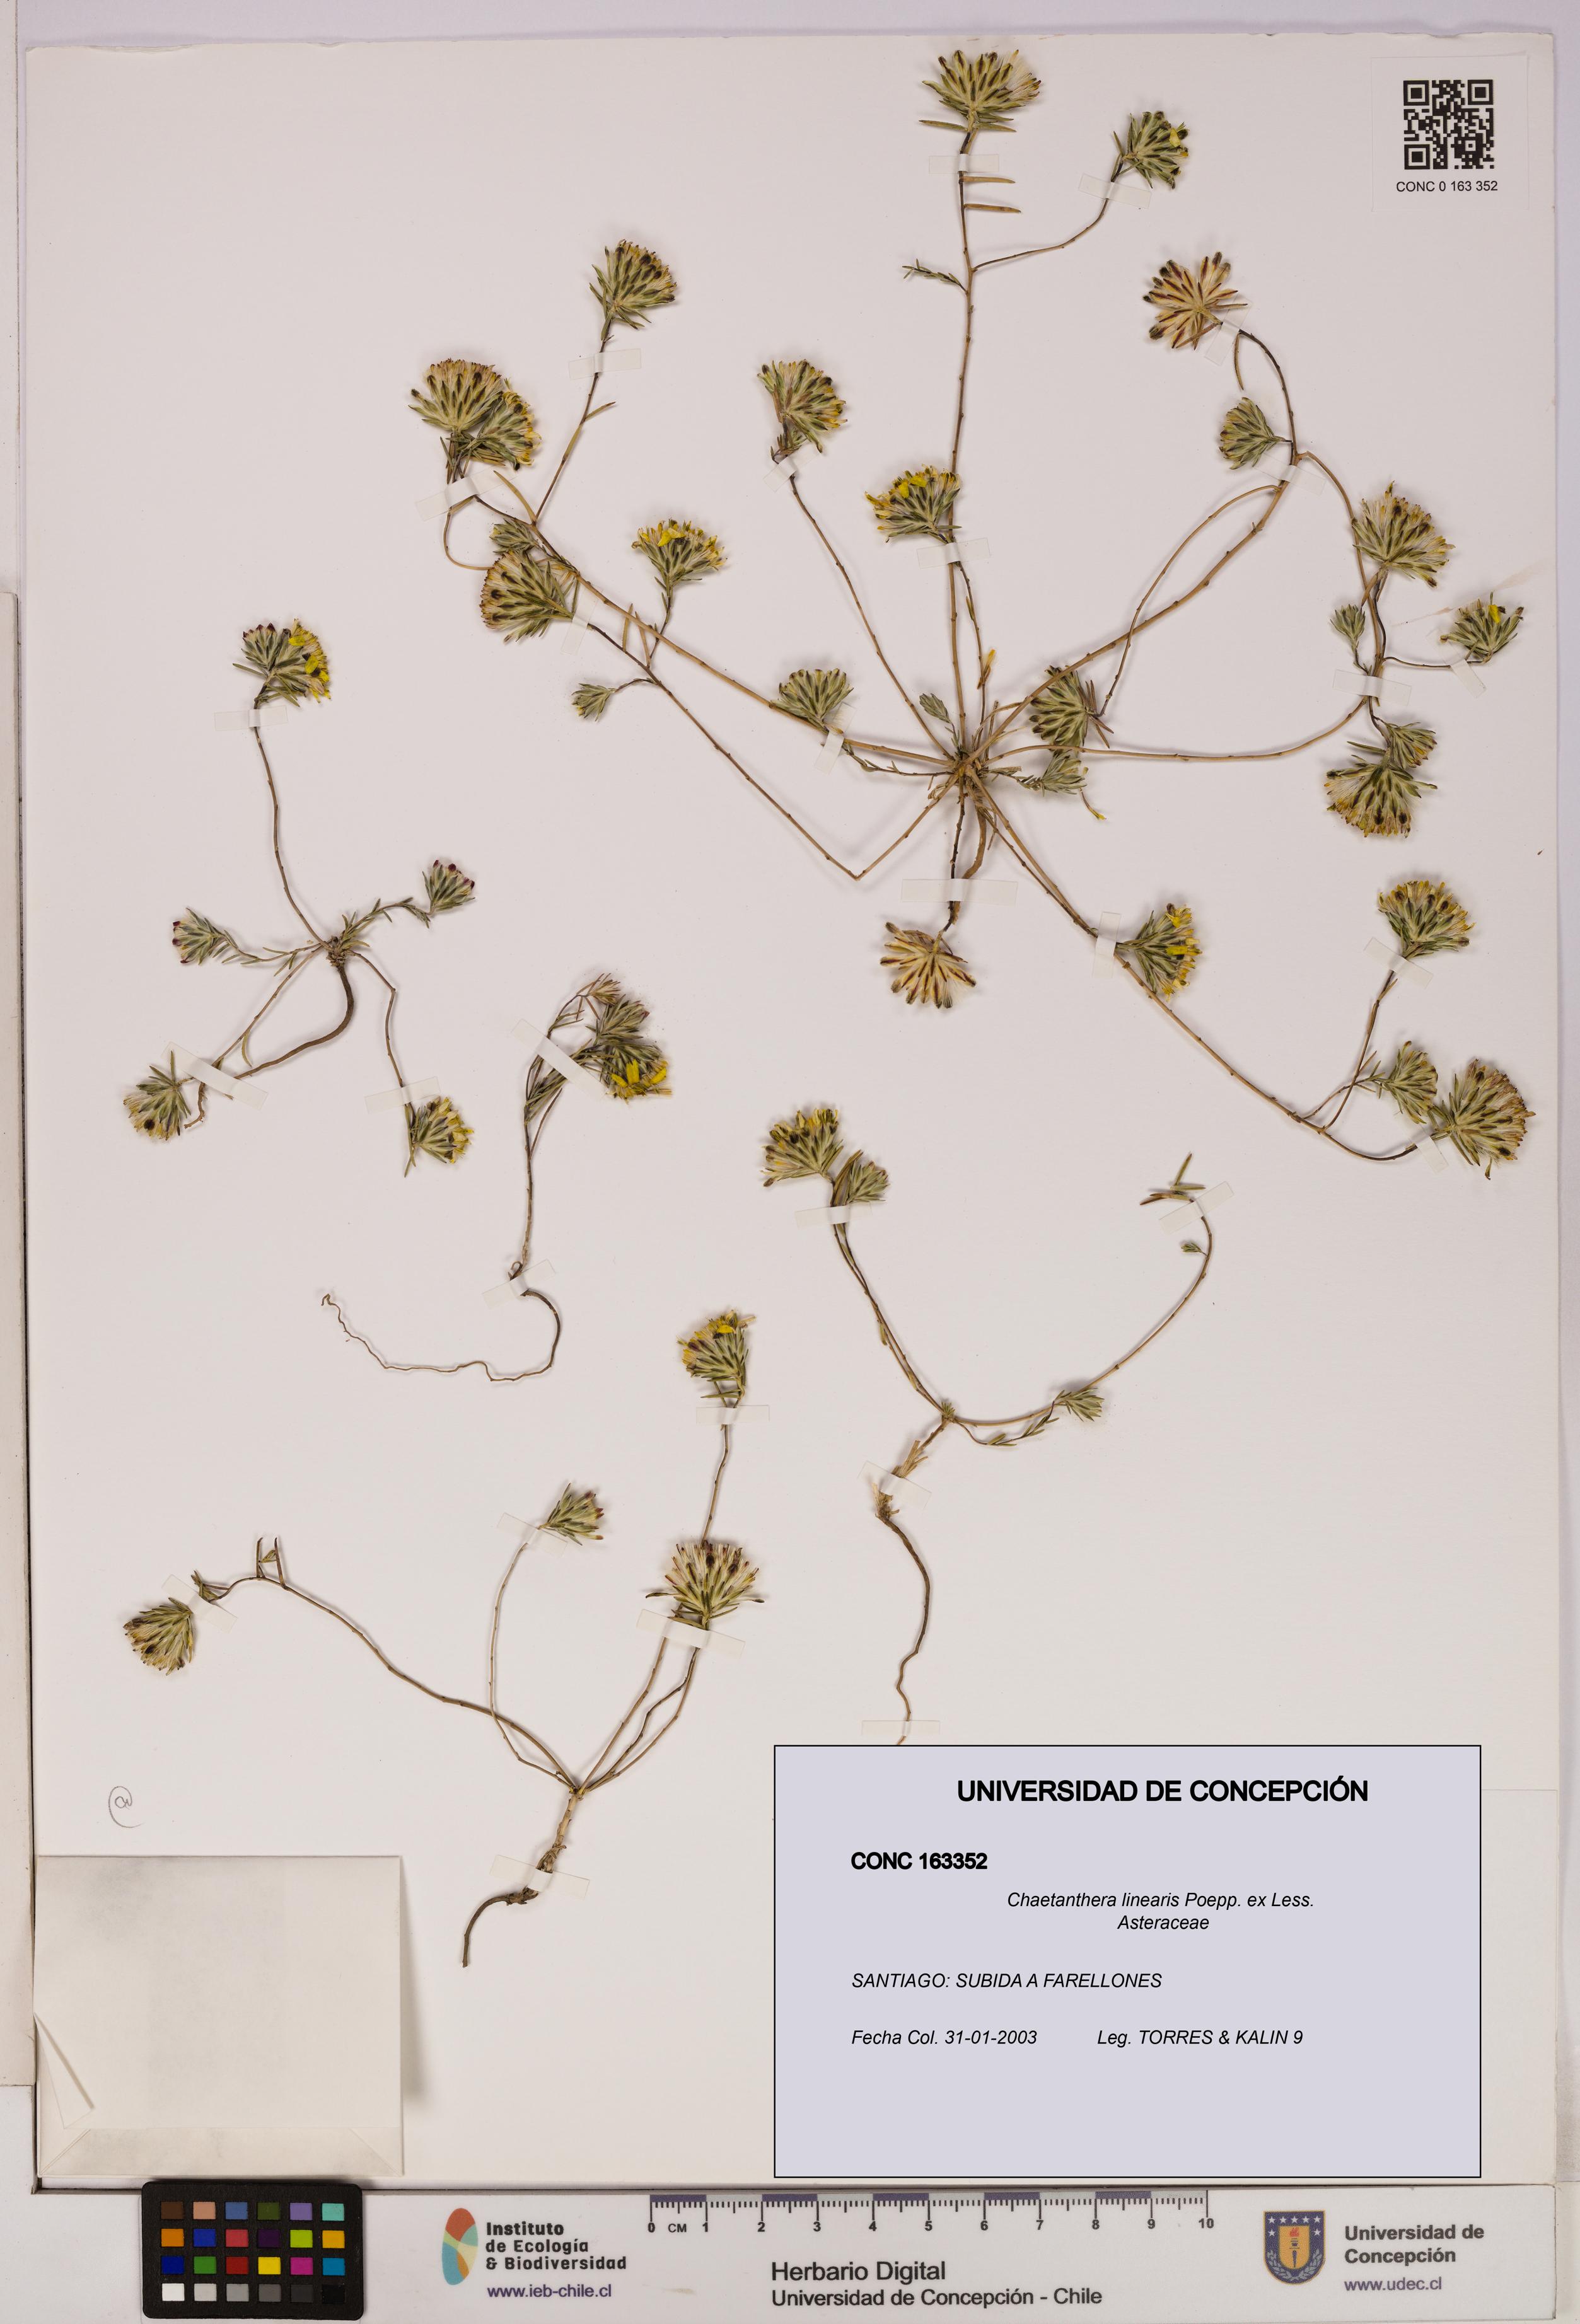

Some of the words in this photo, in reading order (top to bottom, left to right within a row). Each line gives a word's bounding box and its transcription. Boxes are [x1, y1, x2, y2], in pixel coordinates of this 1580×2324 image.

[1396, 181, 1436, 192] CONC
[1439, 180, 1446, 192] 0
[1451, 180, 1472, 192] 163
[1475, 180, 1498, 192] 352
[486, 2221, 564, 2236] Instituto
[648, 2222, 656, 2233] 0
[668, 2223, 687, 2233] CM
[702, 2221, 709, 2233] 1
[757, 2221, 765, 2233] 2
[813, 2221, 822, 2233] 3
[868, 2221, 878, 2232] 4
[924, 2220, 933, 2232] 5
[980, 2220, 989, 2231] 6
[1036, 2219, 1044, 2231] 7
[1091, 2219, 1100, 2230] 8
[1147, 2219, 1156, 2229] 9
[1198, 2218, 1214, 2229] 10
[1345, 2224, 1456, 2241] Universidad
[1461, 2224, 1485, 2240] de
[485, 2239, 506, 2253] de
[513, 2238, 588, 2255] Ecología
[485, 2257, 498, 2270] &
[504, 2255, 627, 2270] Biodiversidad
[1344, 2247, 1456, 2267] Concepción
[772, 2261, 869, 2281] Herbario
[876, 2260, 946, 2286] Digital
[487, 2284, 612, 2298] www.ieb-chile.cl
[1344, 2276, 1442, 2291] www.udec.cl
[772, 2289, 885, 2306] Universidad
[890, 2289, 915, 2306] de
[921, 2287, 1034, 2309] Concepción
[1054, 2287, 1103, 2304] Chile
